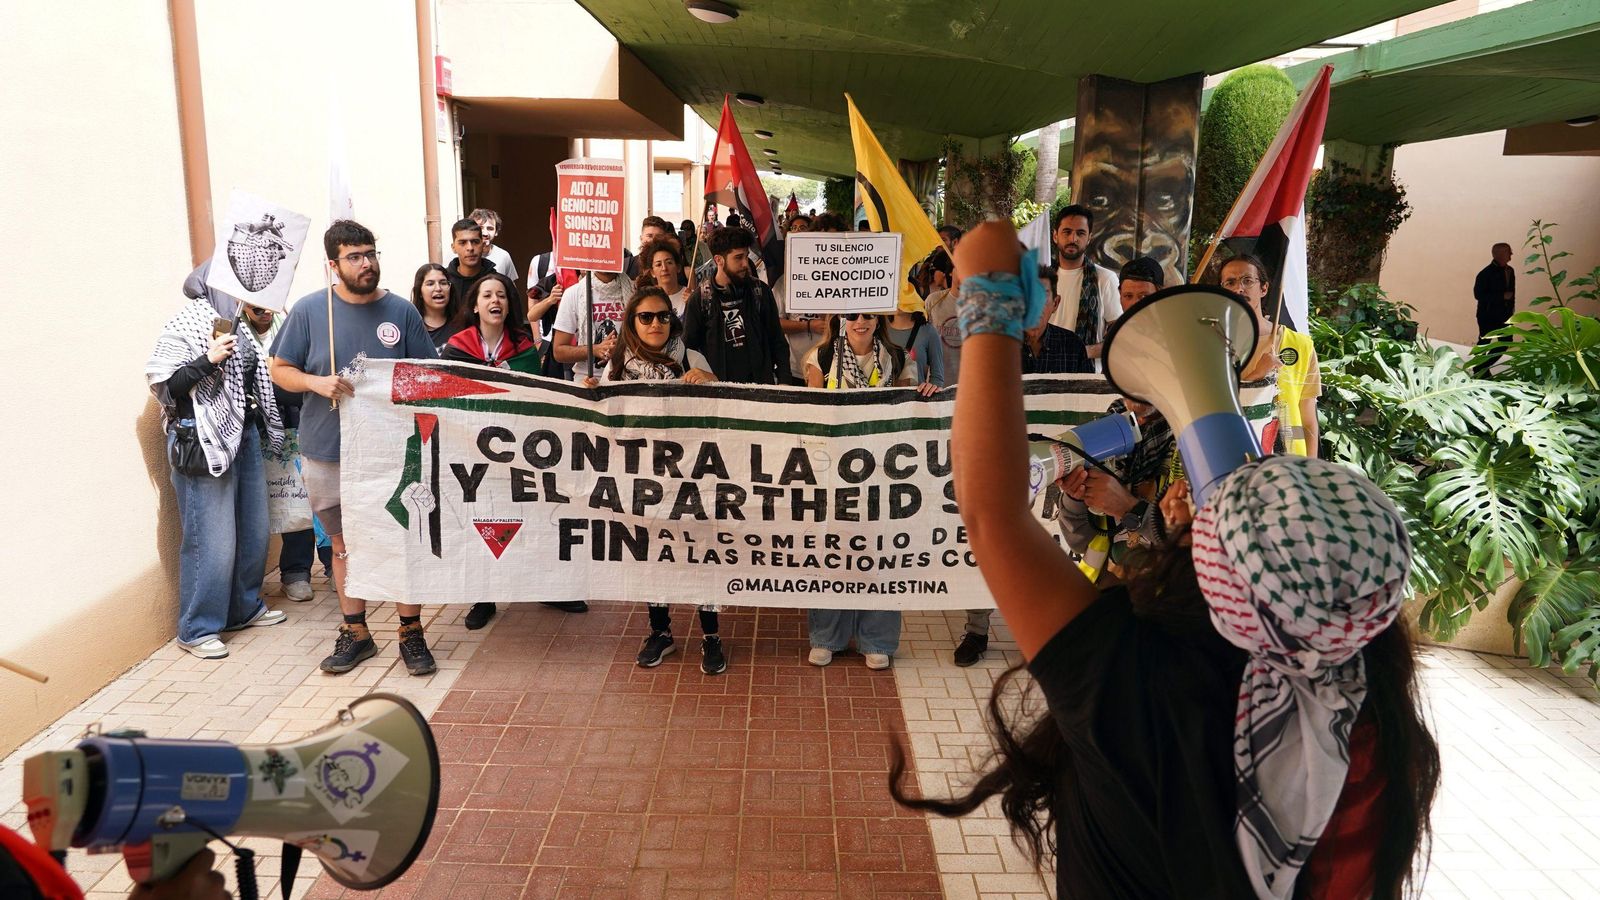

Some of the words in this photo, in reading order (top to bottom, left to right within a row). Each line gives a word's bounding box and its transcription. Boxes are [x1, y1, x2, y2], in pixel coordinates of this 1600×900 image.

[570, 181, 594, 196] ALTO
[595, 182, 609, 197] AL
[561, 198, 619, 215] GENOCIDIO
[564, 215, 614, 232] SIONISTA
[568, 232, 581, 247] DE
[582, 233, 611, 249] GAZA
[815, 243, 828, 252] TU
[830, 243, 874, 252] SILENCIO
[798, 256, 810, 265] TE
[812, 256, 839, 265] HACE
[841, 255, 890, 265] CÓMPLICE
[792, 273, 808, 281] DEL
[811, 269, 885, 281] GENOCIDIO
[796, 291, 812, 299] DEL
[814, 286, 889, 299] APARTHEID
[476, 426, 730, 480] CONTRA
[750, 443, 818, 485] LA
[837, 440, 953, 483] OCU
[449, 463, 490, 503] Y
[510, 467, 571, 503] EL
[588, 476, 923, 522] APARTHEID
[559, 518, 649, 561] FIN
[658, 528, 696, 542] AL
[717, 532, 911, 550] COMERCIO
[658, 544, 676, 563] A
[687, 548, 739, 565] LAS
[751, 551, 931, 572] RELACIONES
[942, 549, 978, 567] CO
[726, 578, 949, 595] @MALAGAPORPALESTINA
